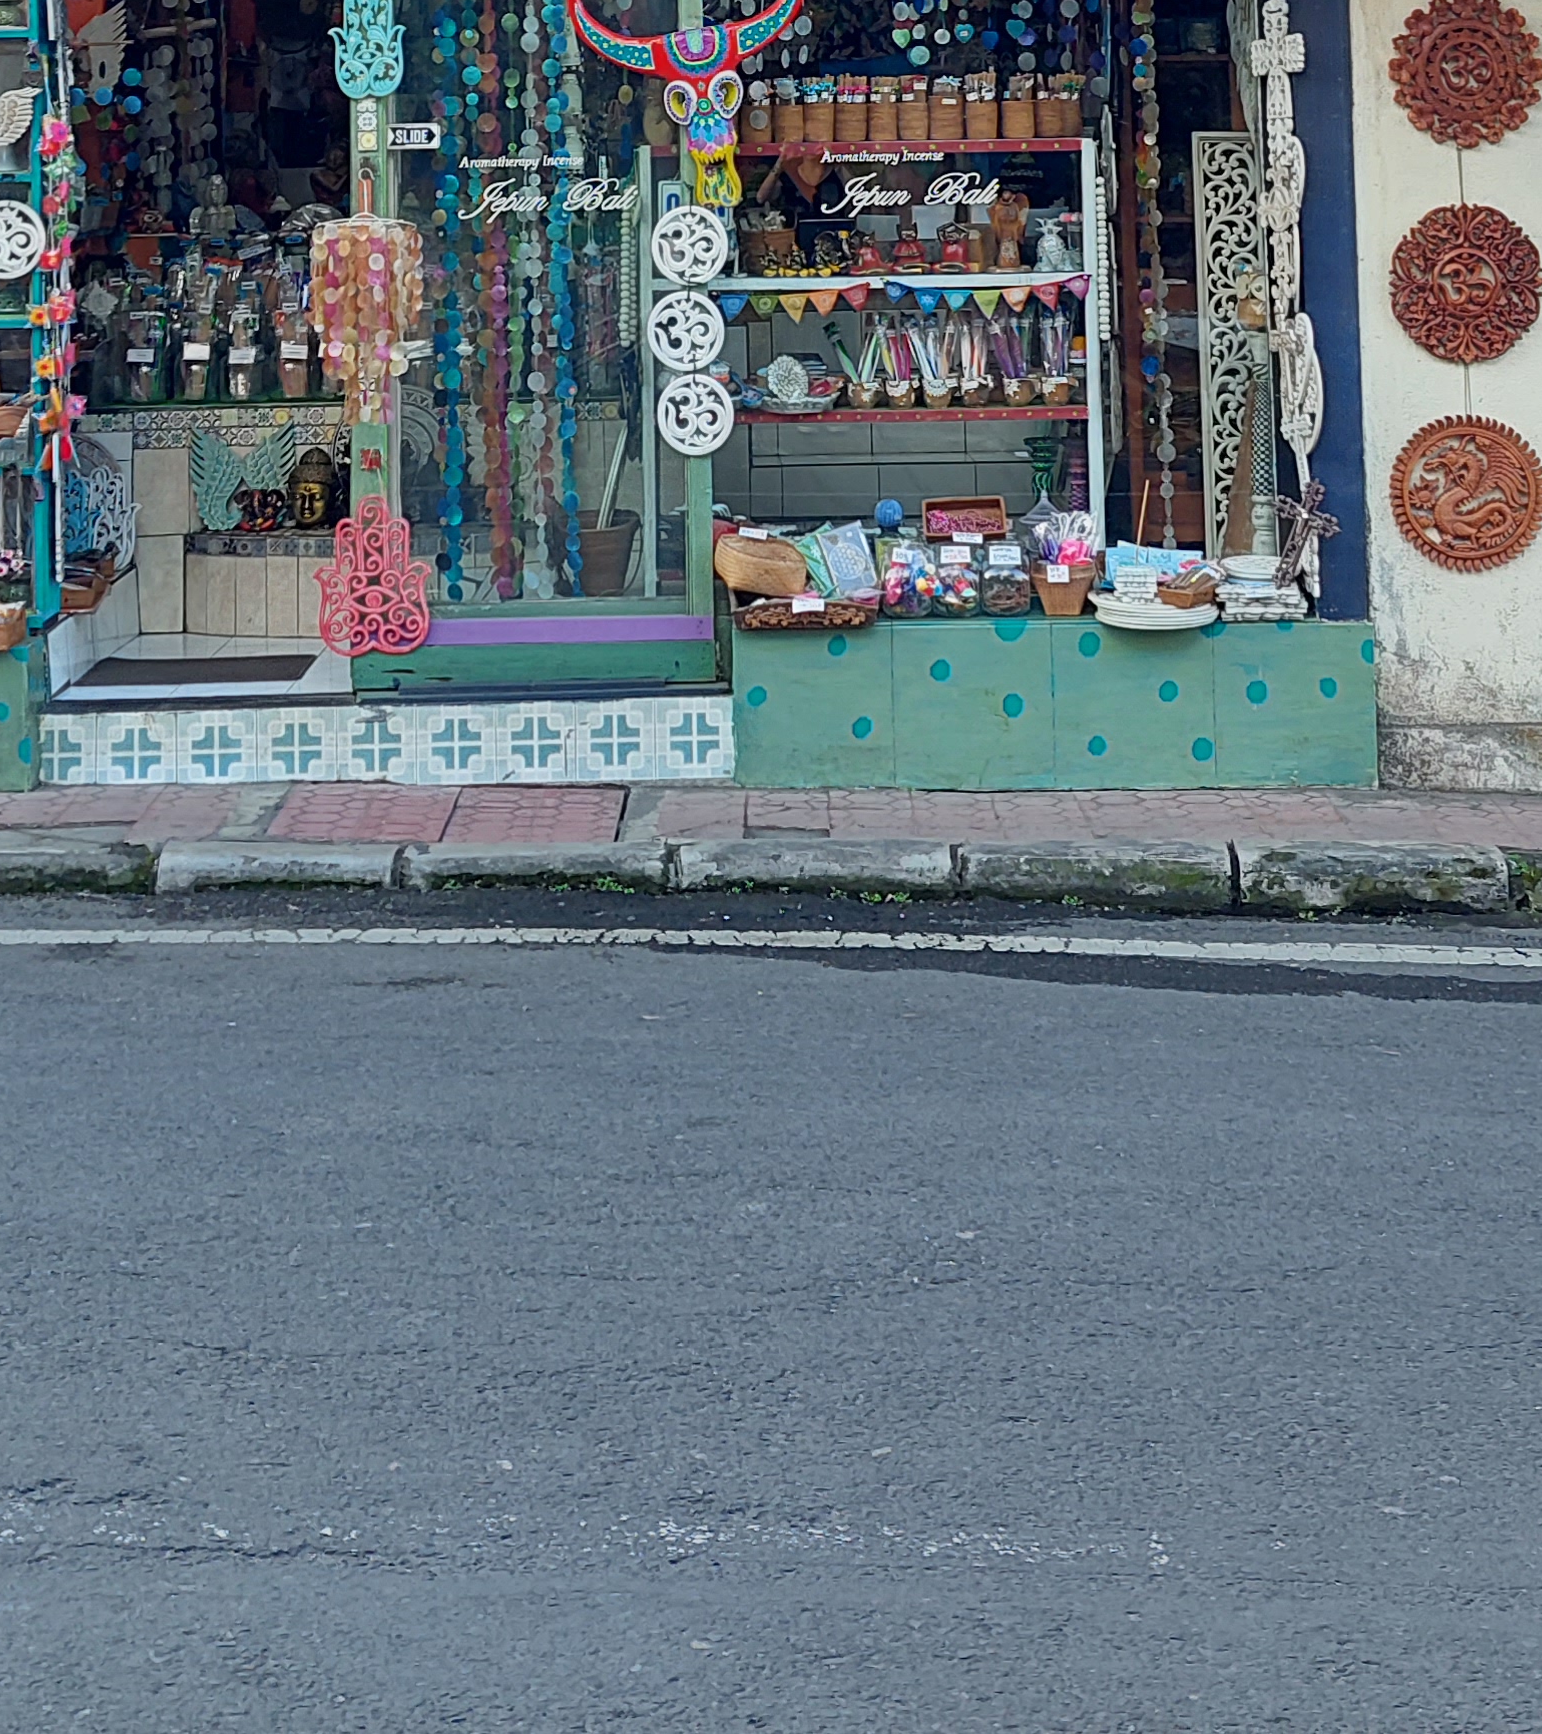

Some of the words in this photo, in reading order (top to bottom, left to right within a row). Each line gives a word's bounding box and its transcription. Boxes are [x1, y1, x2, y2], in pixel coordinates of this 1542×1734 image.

[395, 129, 430, 144] SLIDE
[459, 155, 539, 170] Aromatherapy
[542, 155, 585, 167] Incense
[819, 150, 900, 165] Aromatherapy
[901, 149, 945, 162] Incense
[457, 177, 550, 224] Jepun
[562, 177, 640, 212] Bali
[820, 172, 912, 217] Jepun
[923, 172, 1000, 206] Bali
